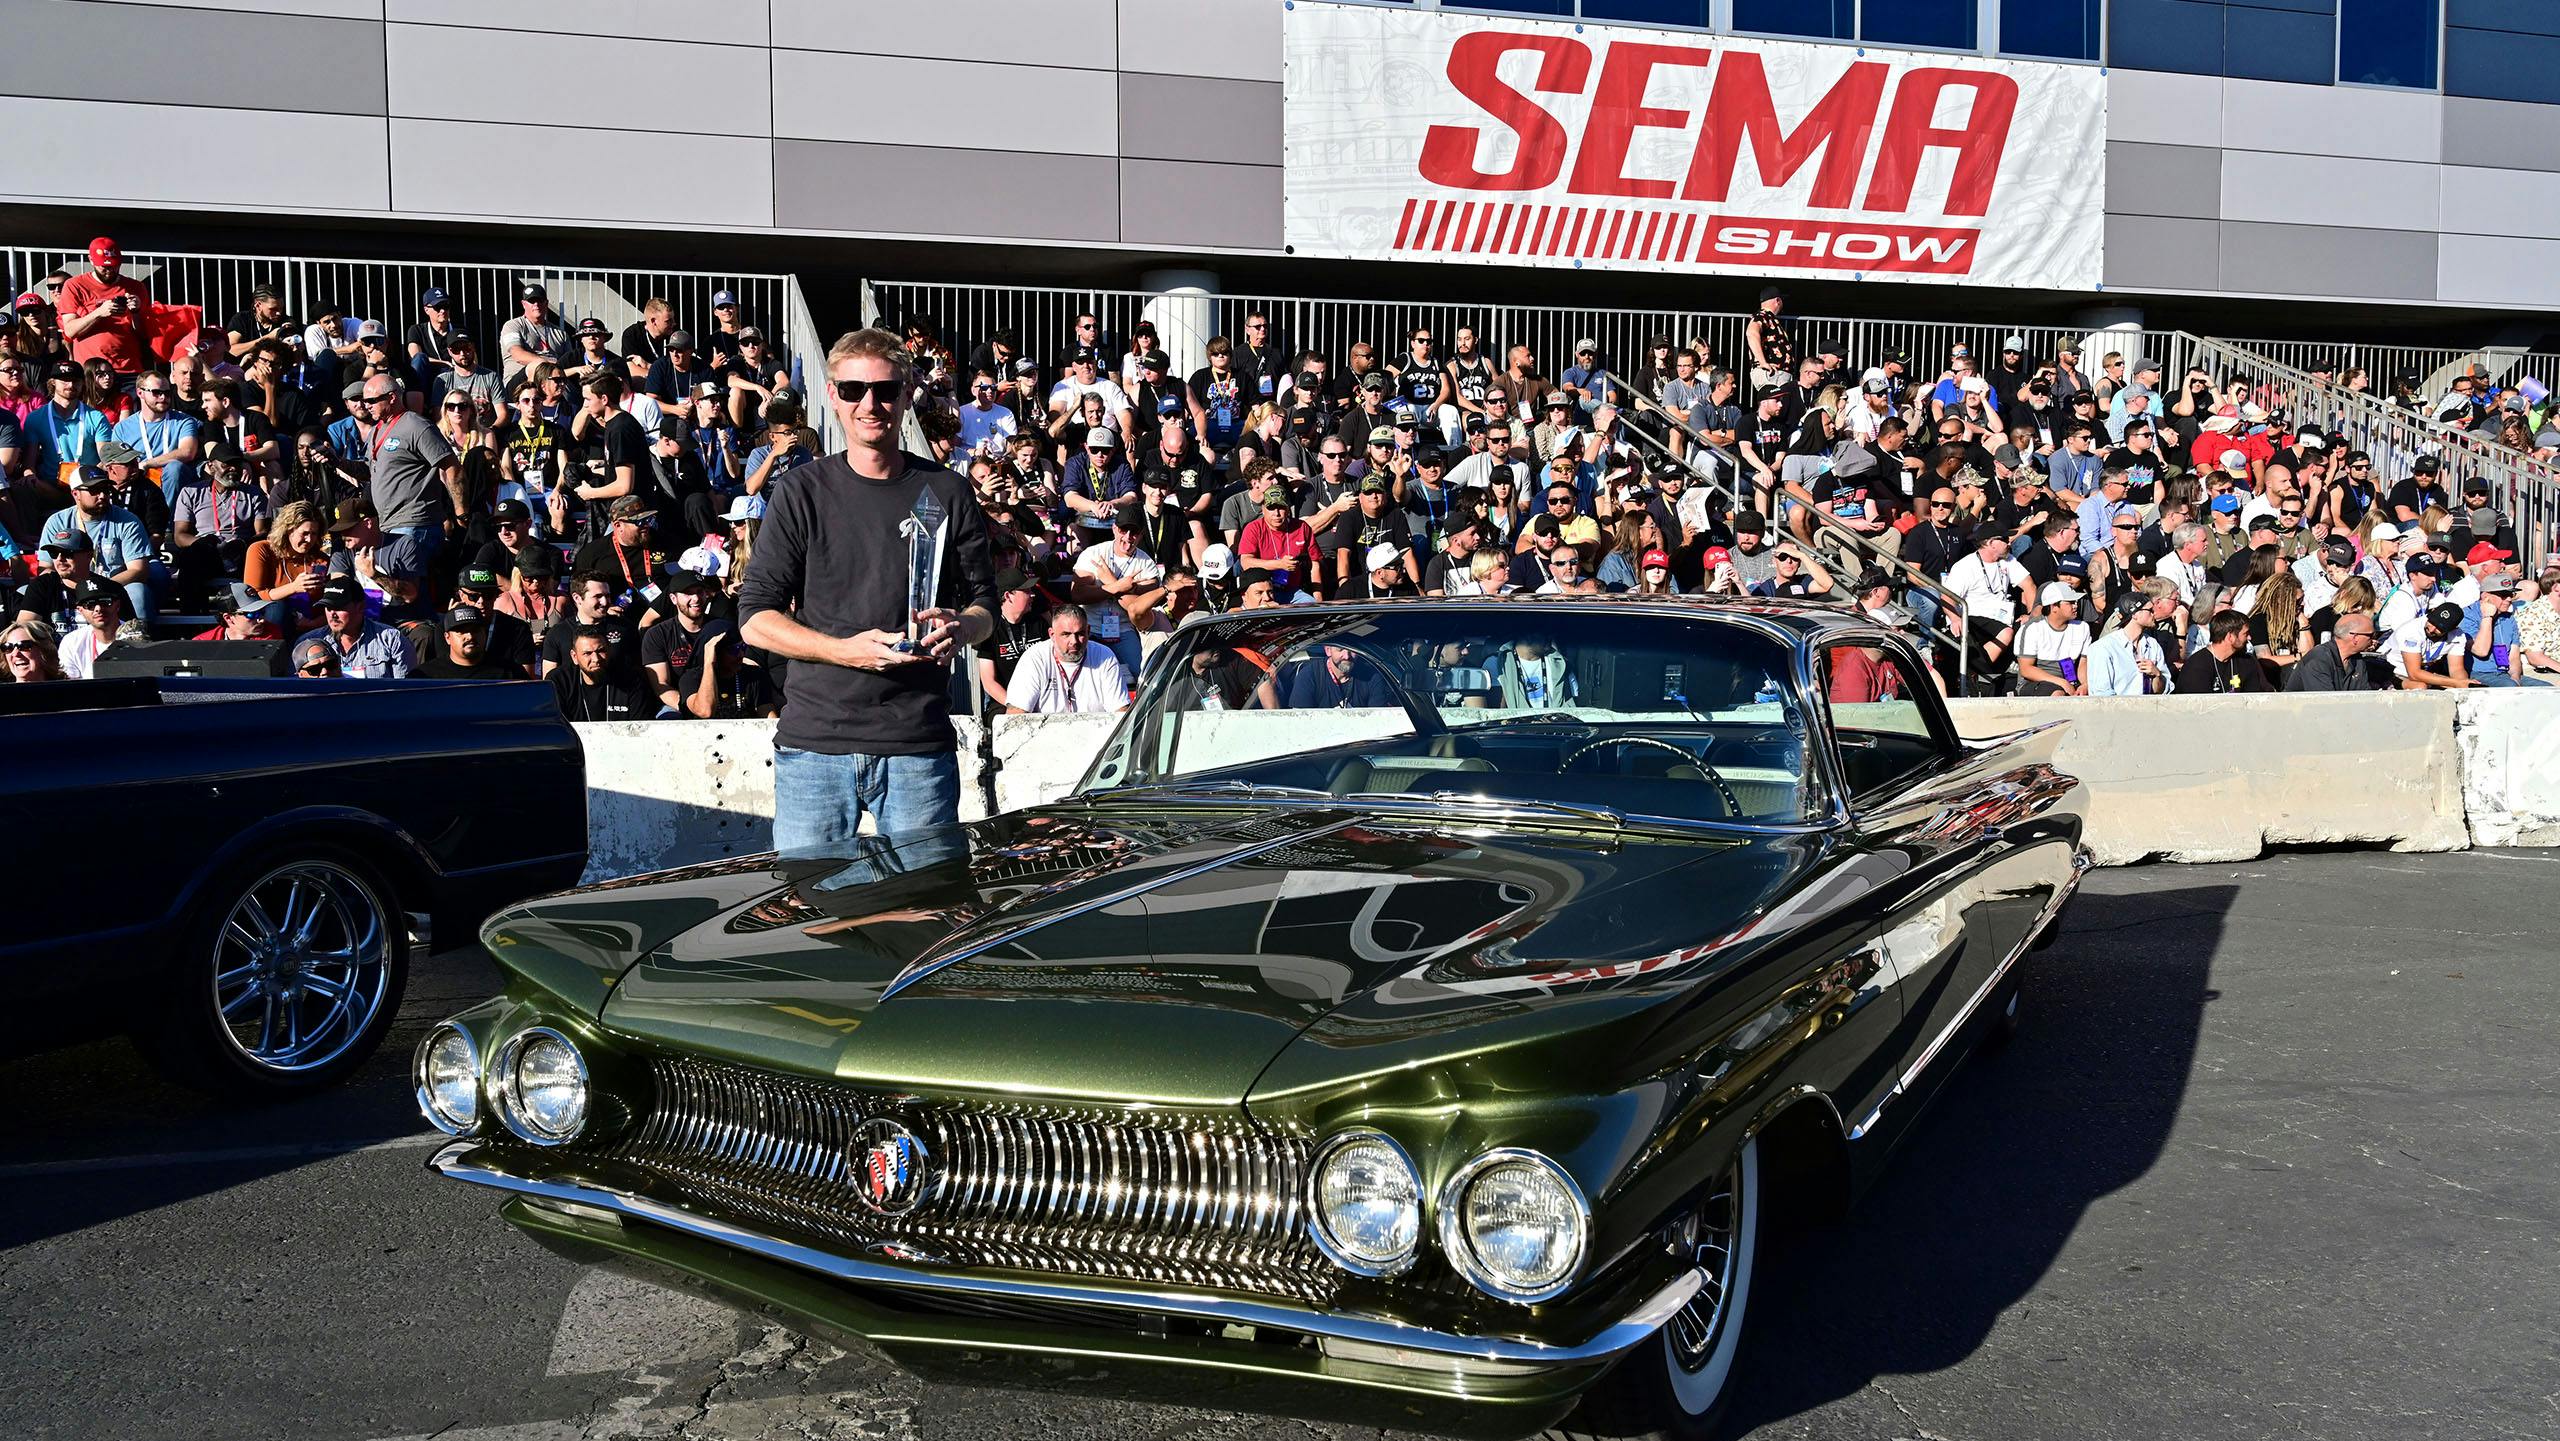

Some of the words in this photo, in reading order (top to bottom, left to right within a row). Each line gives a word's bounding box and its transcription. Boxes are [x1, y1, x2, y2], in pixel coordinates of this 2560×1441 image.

[1419, 31, 2019, 217] SEMA
[1715, 227, 1968, 263] SHOW
[86, 580, 98, 592] LA
